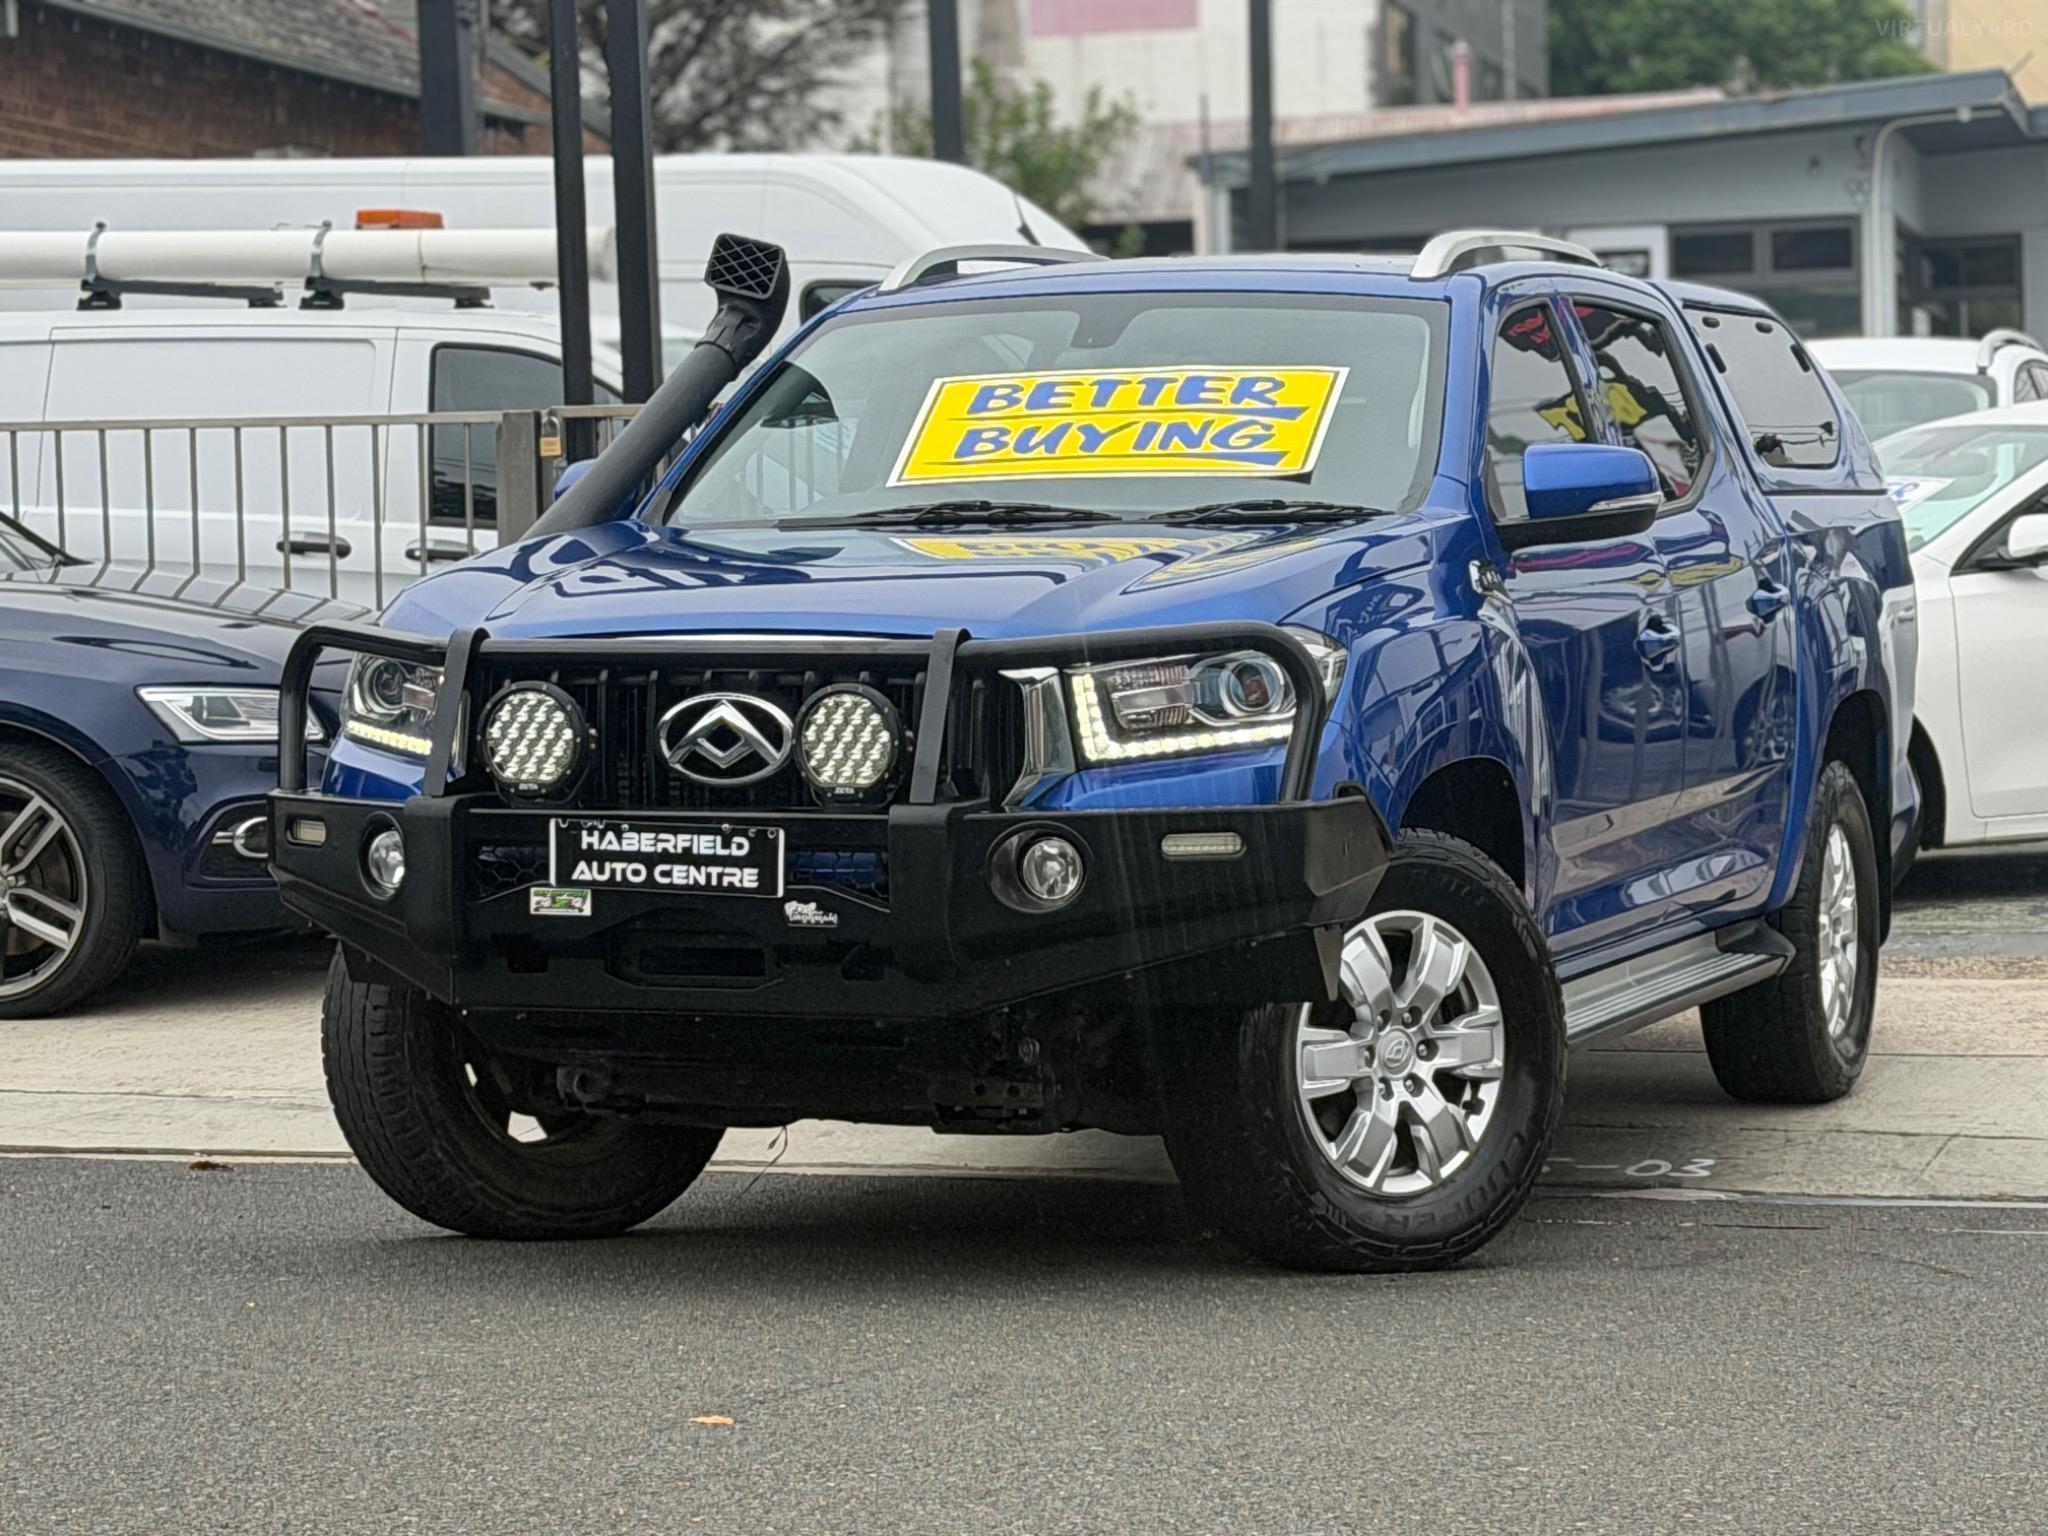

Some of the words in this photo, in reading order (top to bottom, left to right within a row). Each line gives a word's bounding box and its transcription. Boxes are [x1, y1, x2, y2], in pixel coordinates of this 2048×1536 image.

[966, 375, 1286, 416] BETTER
[953, 419, 1277, 459] BUYING
[581, 830, 750, 857] HABERFIELD
[571, 860, 647, 884] AUTO
[653, 864, 759, 889] CENTRE
